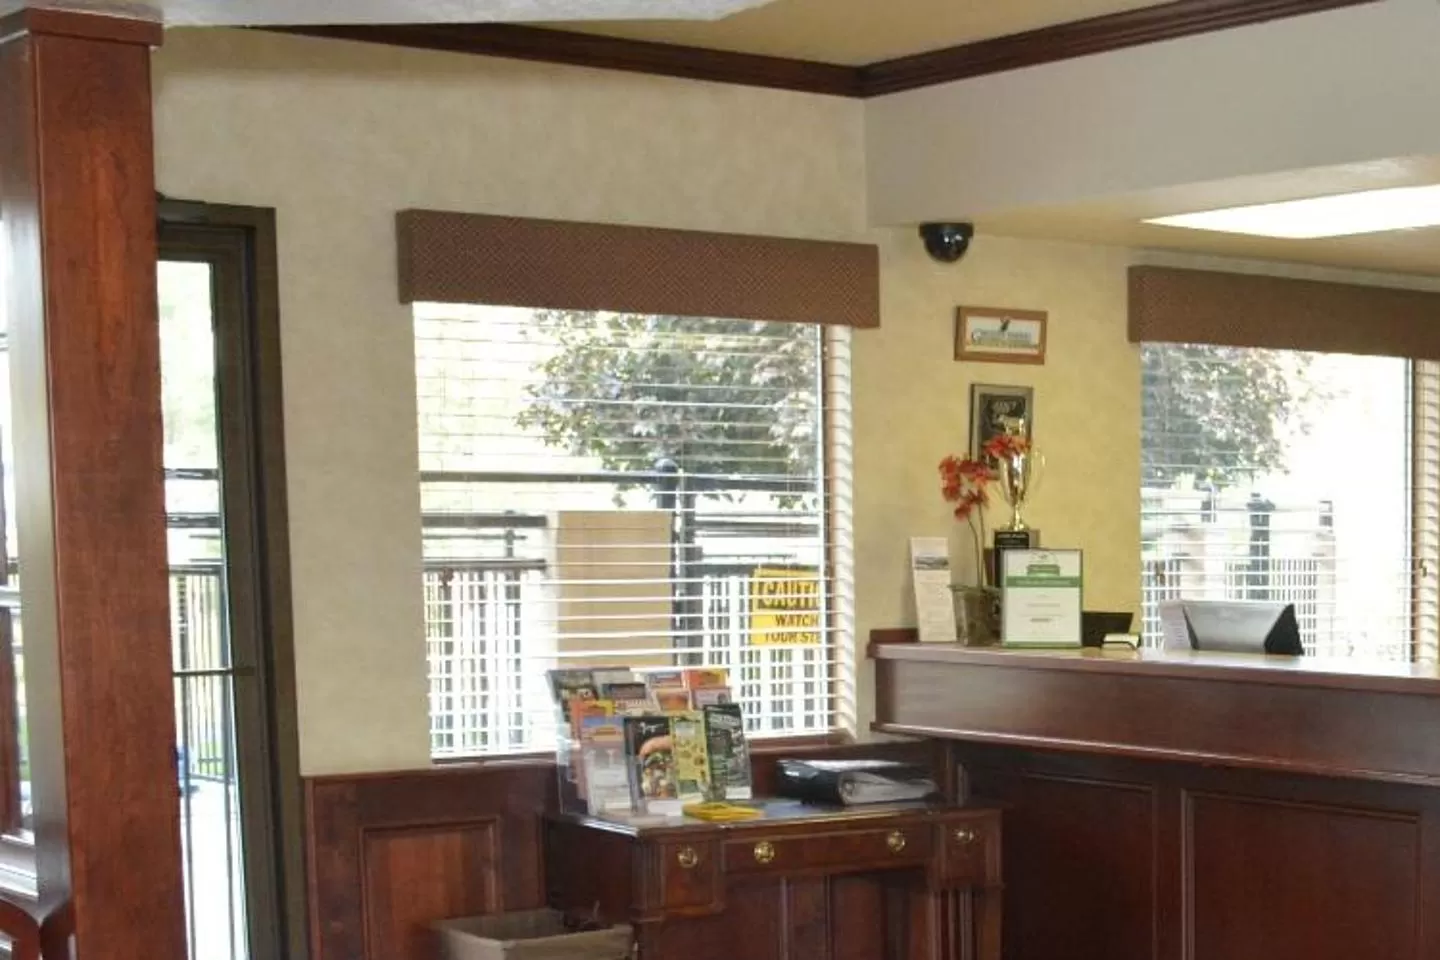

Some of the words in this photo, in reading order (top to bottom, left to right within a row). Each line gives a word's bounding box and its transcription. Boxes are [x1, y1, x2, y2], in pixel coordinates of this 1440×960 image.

[763, 580, 821, 608] CAUTI
[774, 614, 820, 628] WATCH
[799, 631, 821, 644] STE
